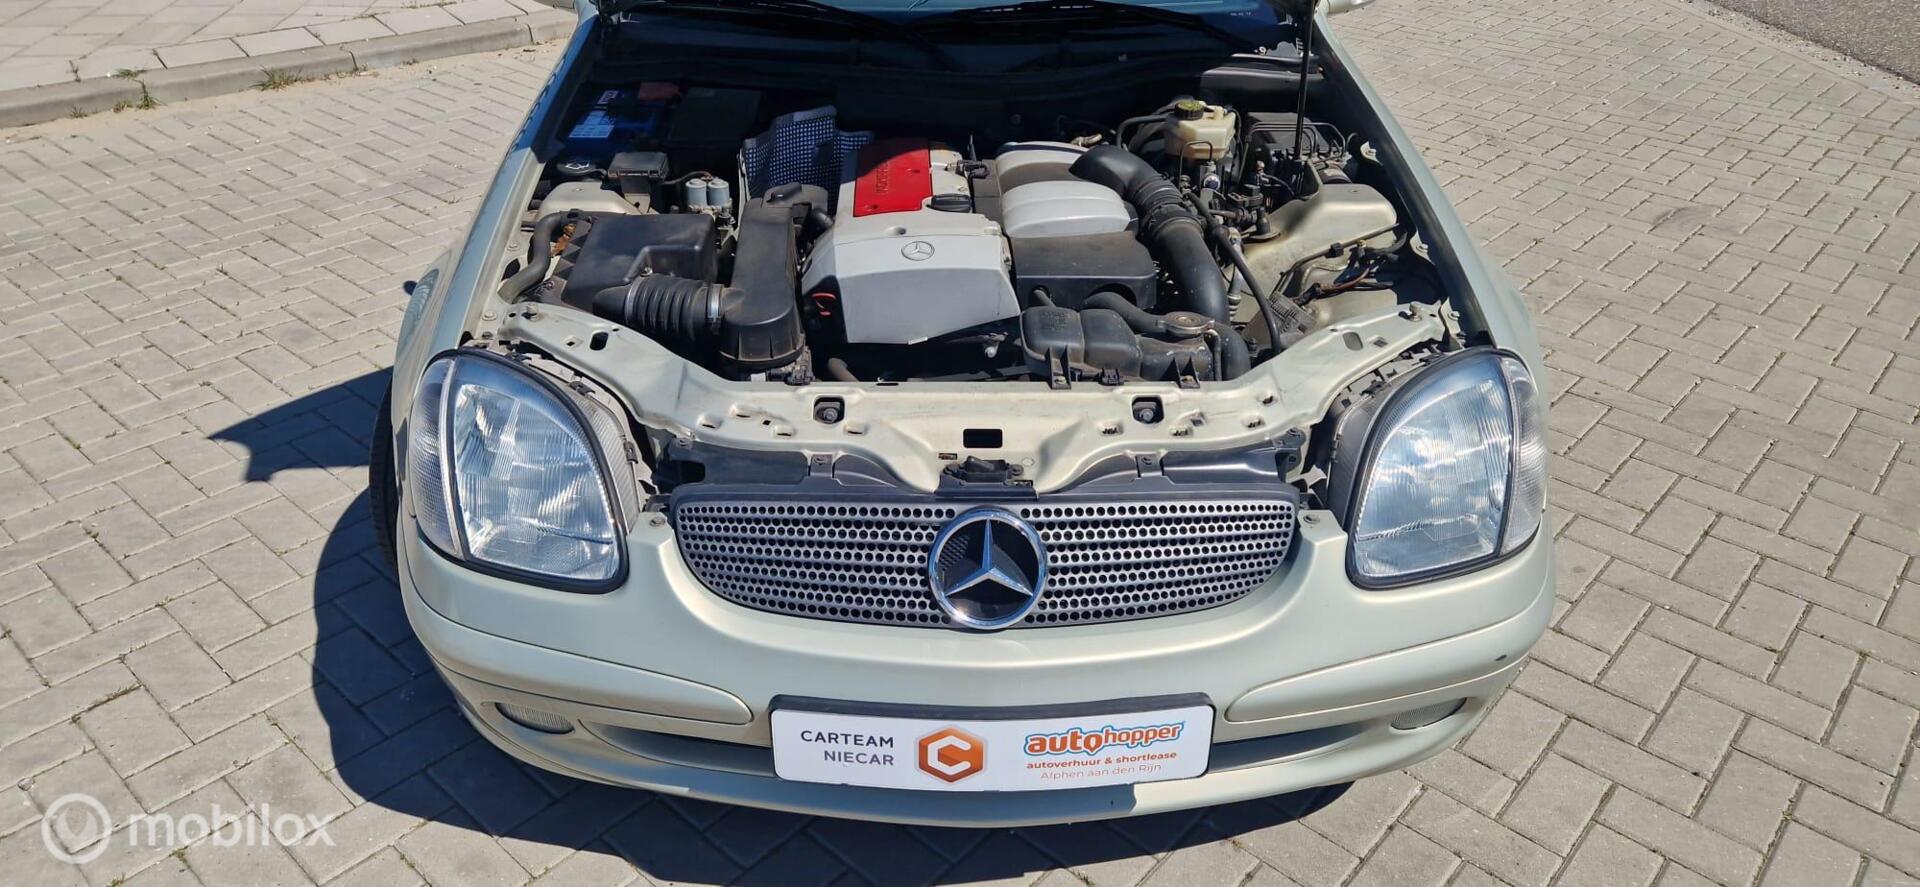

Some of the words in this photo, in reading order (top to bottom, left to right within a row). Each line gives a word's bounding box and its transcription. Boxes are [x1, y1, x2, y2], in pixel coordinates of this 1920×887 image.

[800, 730, 894, 748] CARTEAM
[1026, 724, 1183, 754] autohopper
[823, 750, 894, 766] NIECAR
[1026, 759, 1101, 770] autoverhuur
[1104, 757, 1112, 765] &
[1116, 751, 1177, 764] shortlease
[1040, 770, 1085, 781] Alphen
[1087, 769, 1109, 777] aan
[1112, 765, 1135, 775] den
[1138, 763, 1162, 773] Rijn
